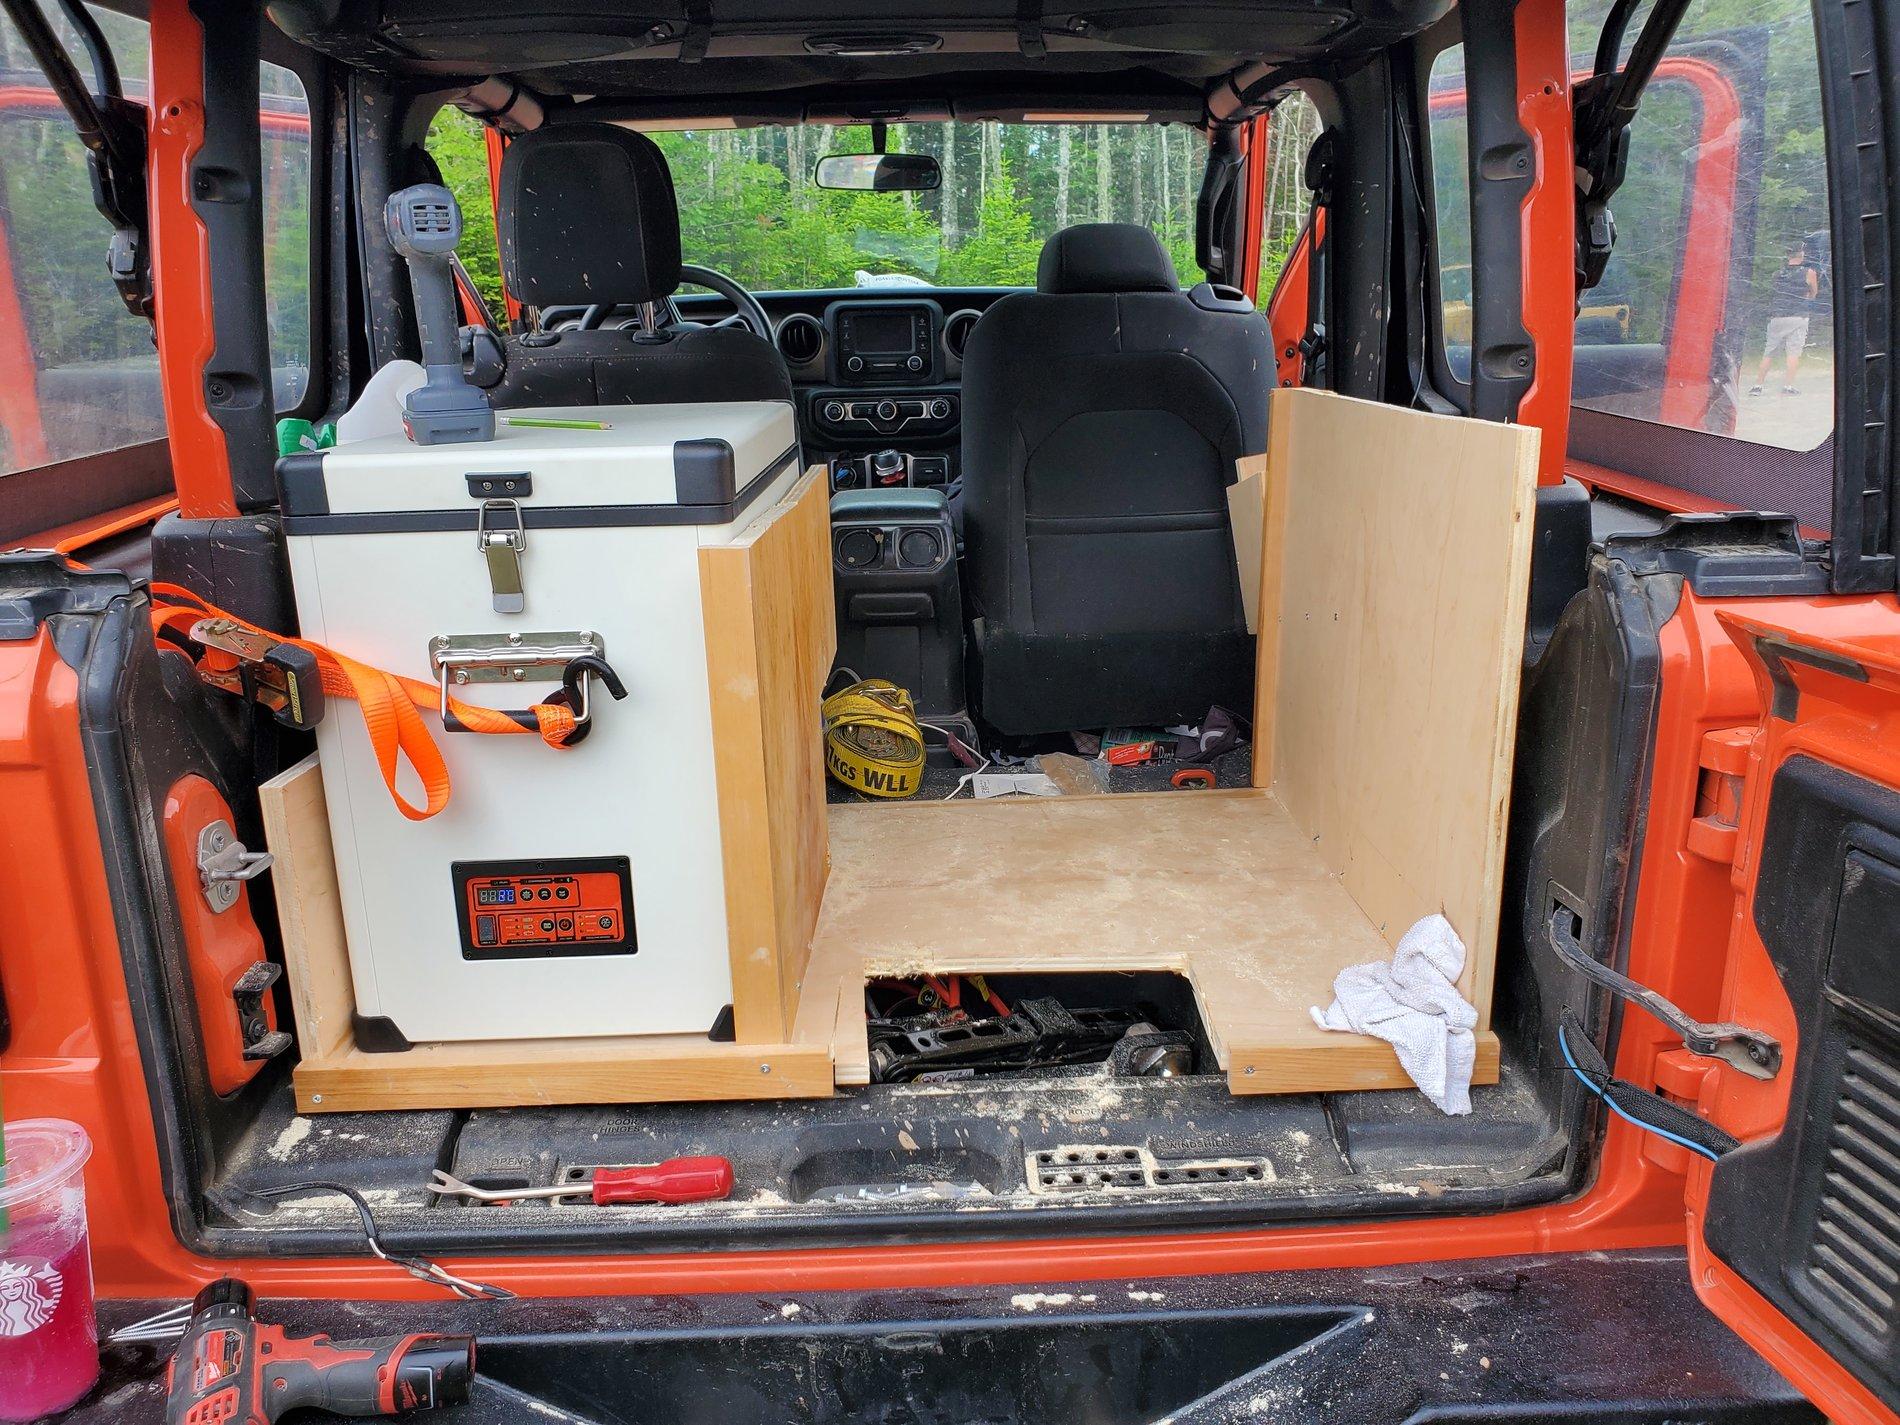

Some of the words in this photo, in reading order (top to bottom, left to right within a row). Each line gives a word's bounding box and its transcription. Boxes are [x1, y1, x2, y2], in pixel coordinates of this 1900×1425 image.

[863, 766, 909, 792] WLL
[607, 1118, 638, 1126] DOOR
[600, 1125, 641, 1134] HINGES
